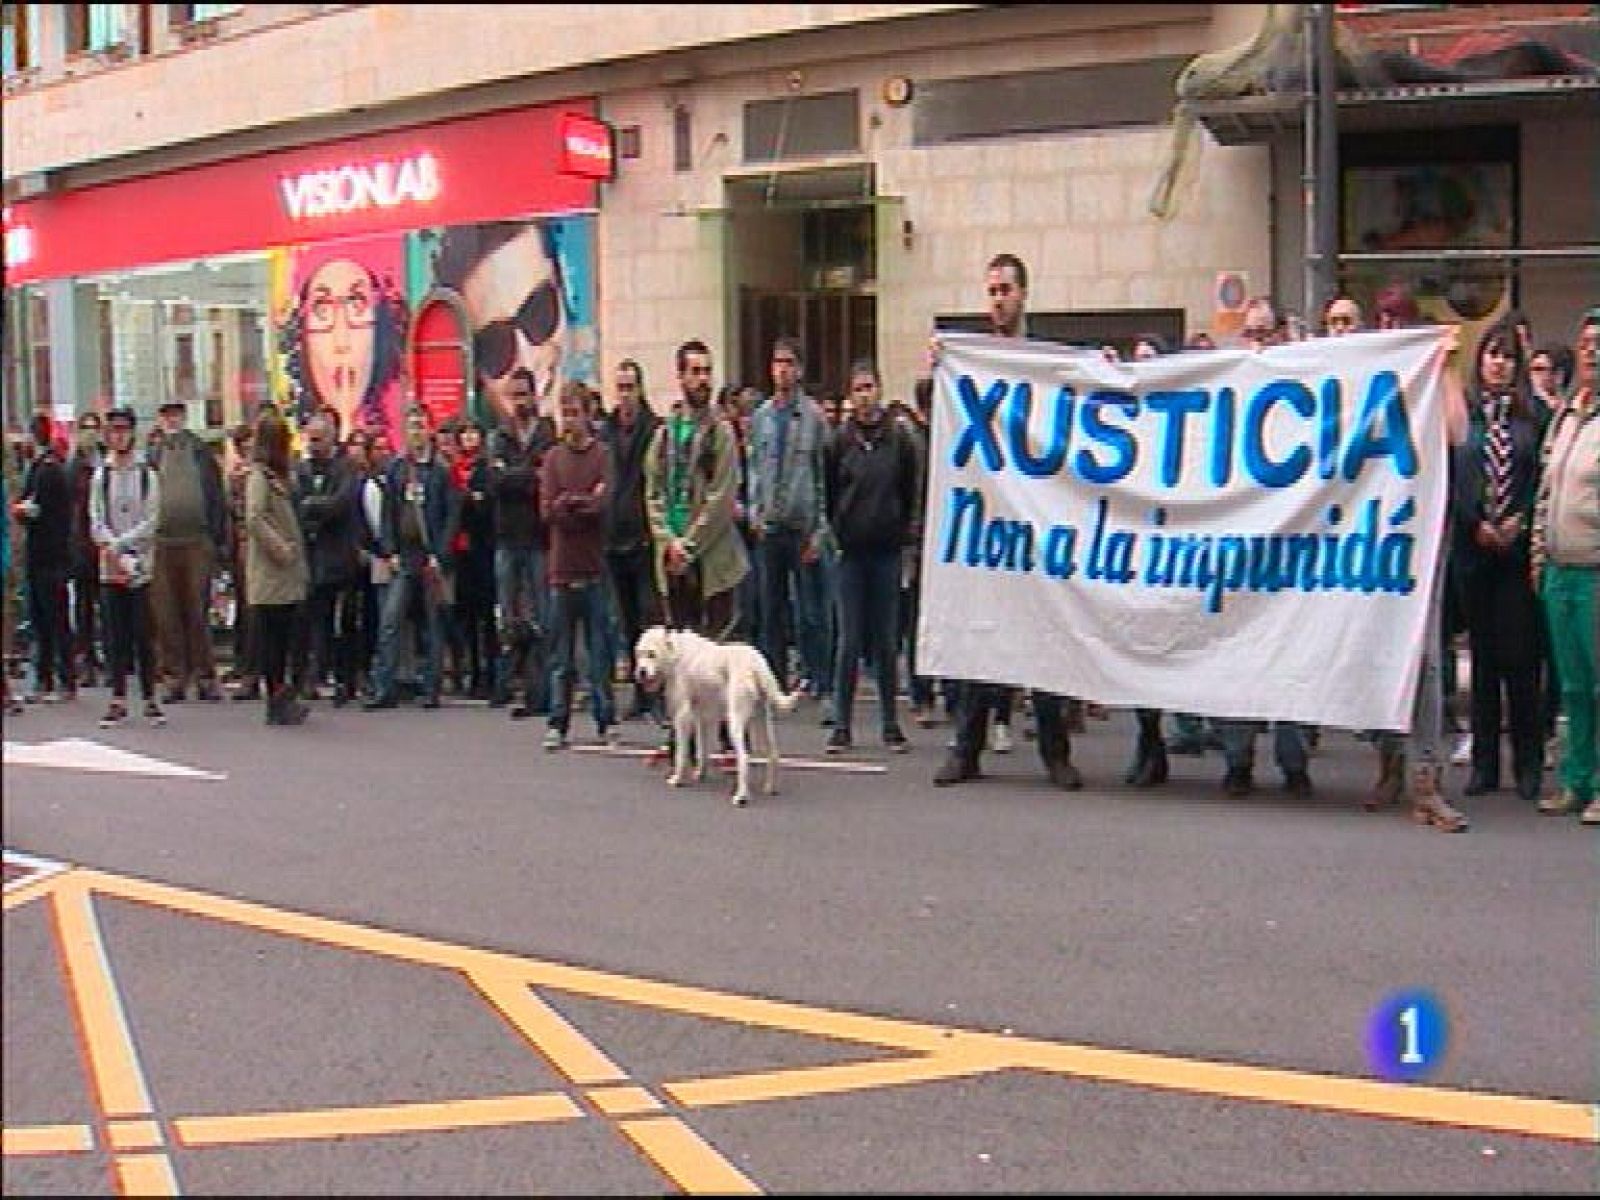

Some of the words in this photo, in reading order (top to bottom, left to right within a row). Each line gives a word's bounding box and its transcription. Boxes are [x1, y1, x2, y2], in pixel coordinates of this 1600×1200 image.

[280, 152, 439, 218] VISIONLAB
[951, 371, 1418, 488] XUSTICIA
[941, 487, 1034, 572] Non
[1043, 523, 1077, 582] a
[1087, 498, 1136, 585] la
[1143, 497, 1416, 613] impunidá
